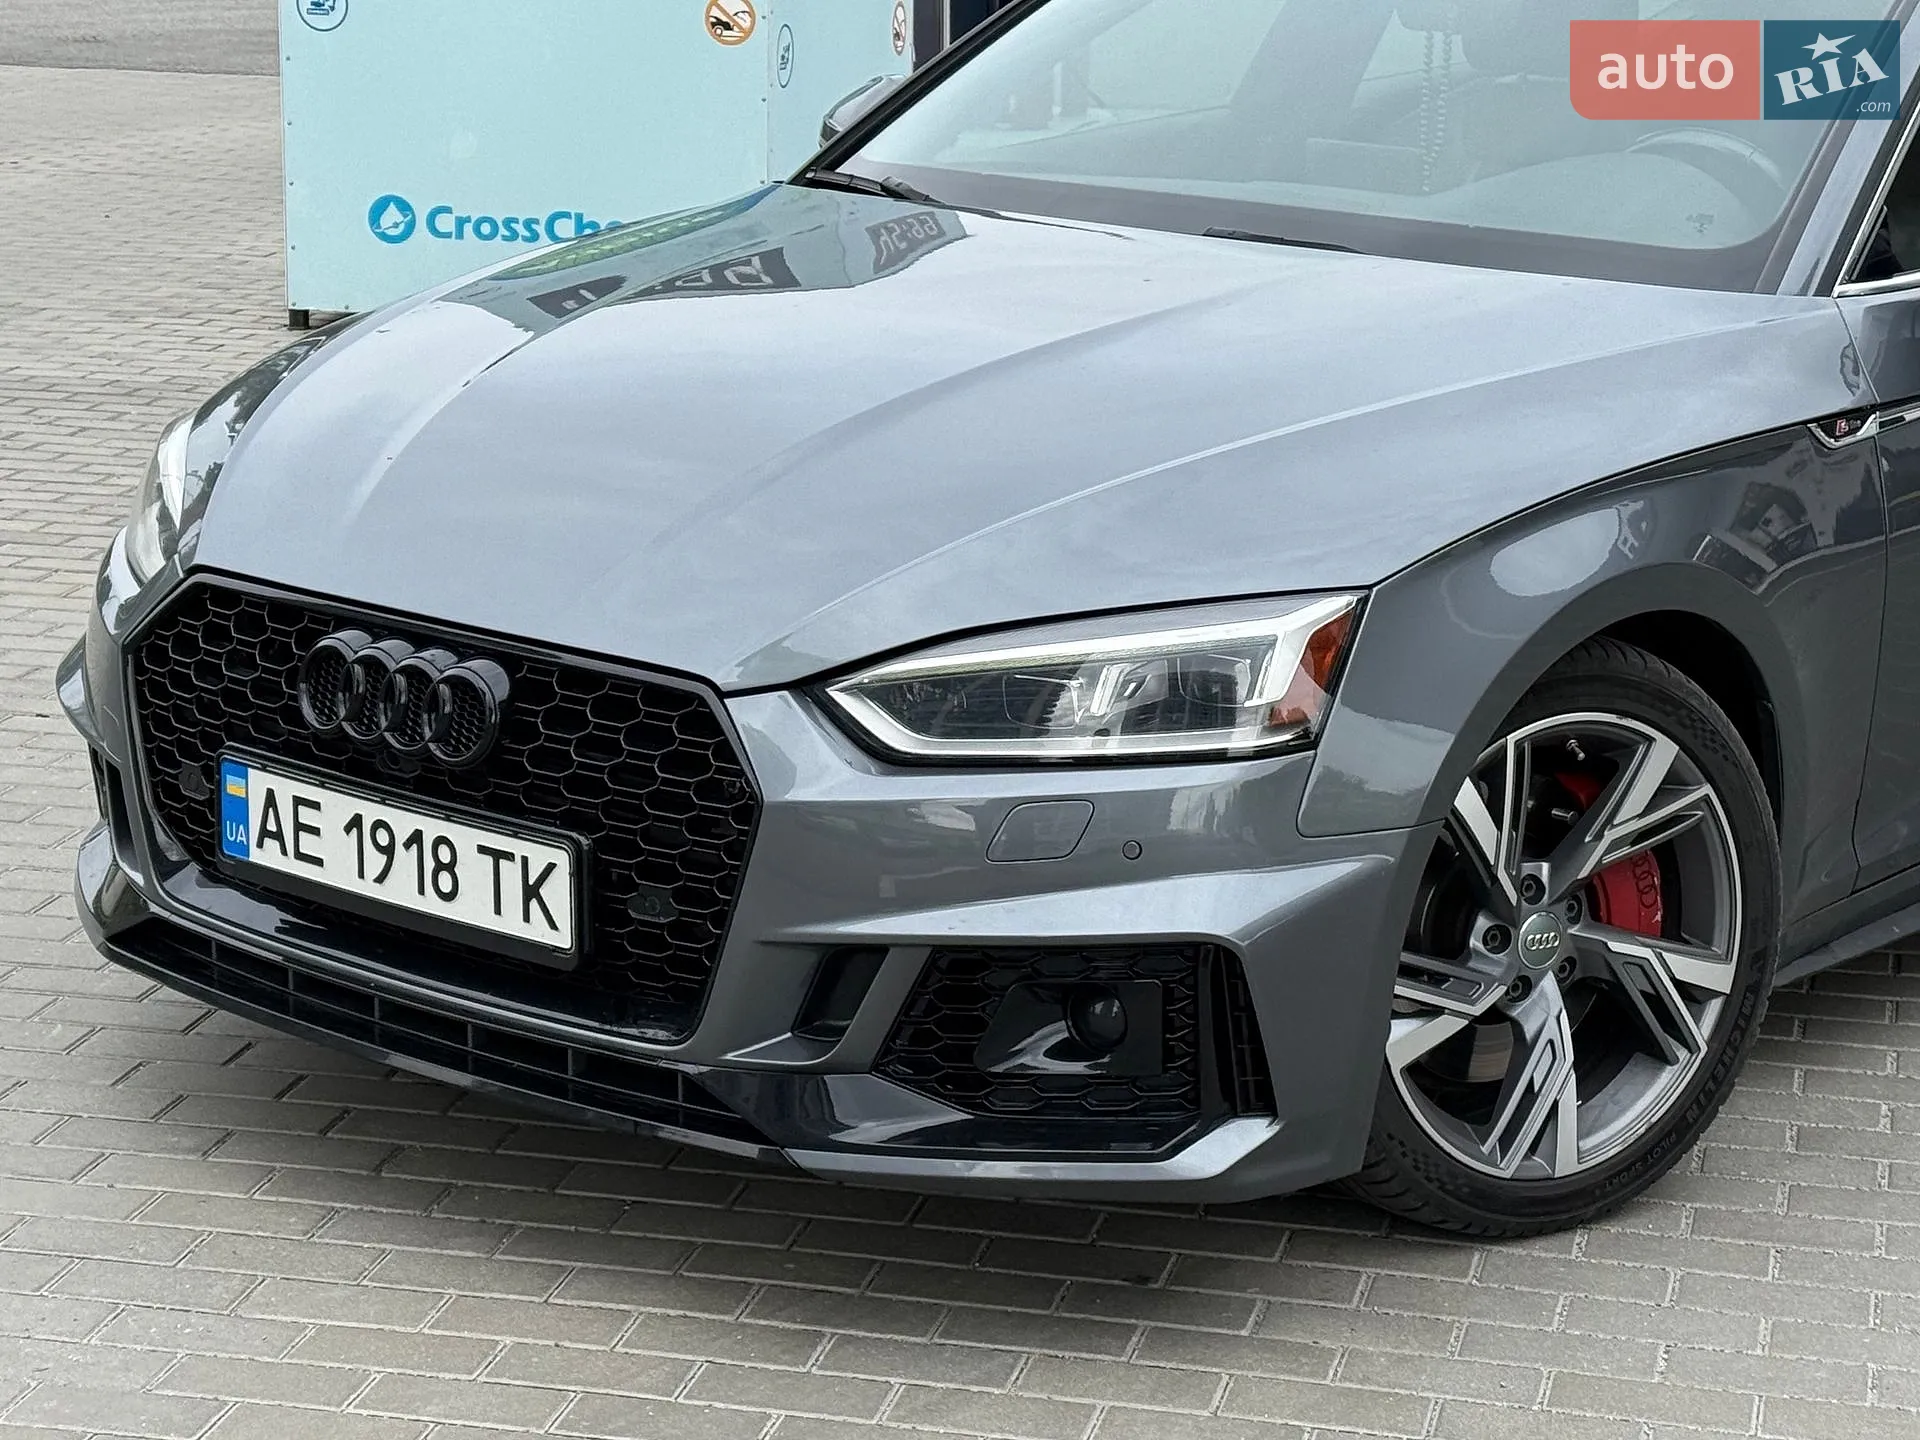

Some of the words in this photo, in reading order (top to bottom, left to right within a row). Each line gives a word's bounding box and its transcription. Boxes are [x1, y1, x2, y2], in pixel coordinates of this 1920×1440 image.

[226, 820, 248, 846] UA
[256, 786, 325, 868] AE
[343, 812, 461, 902] 1918
[476, 843, 561, 932] TK
